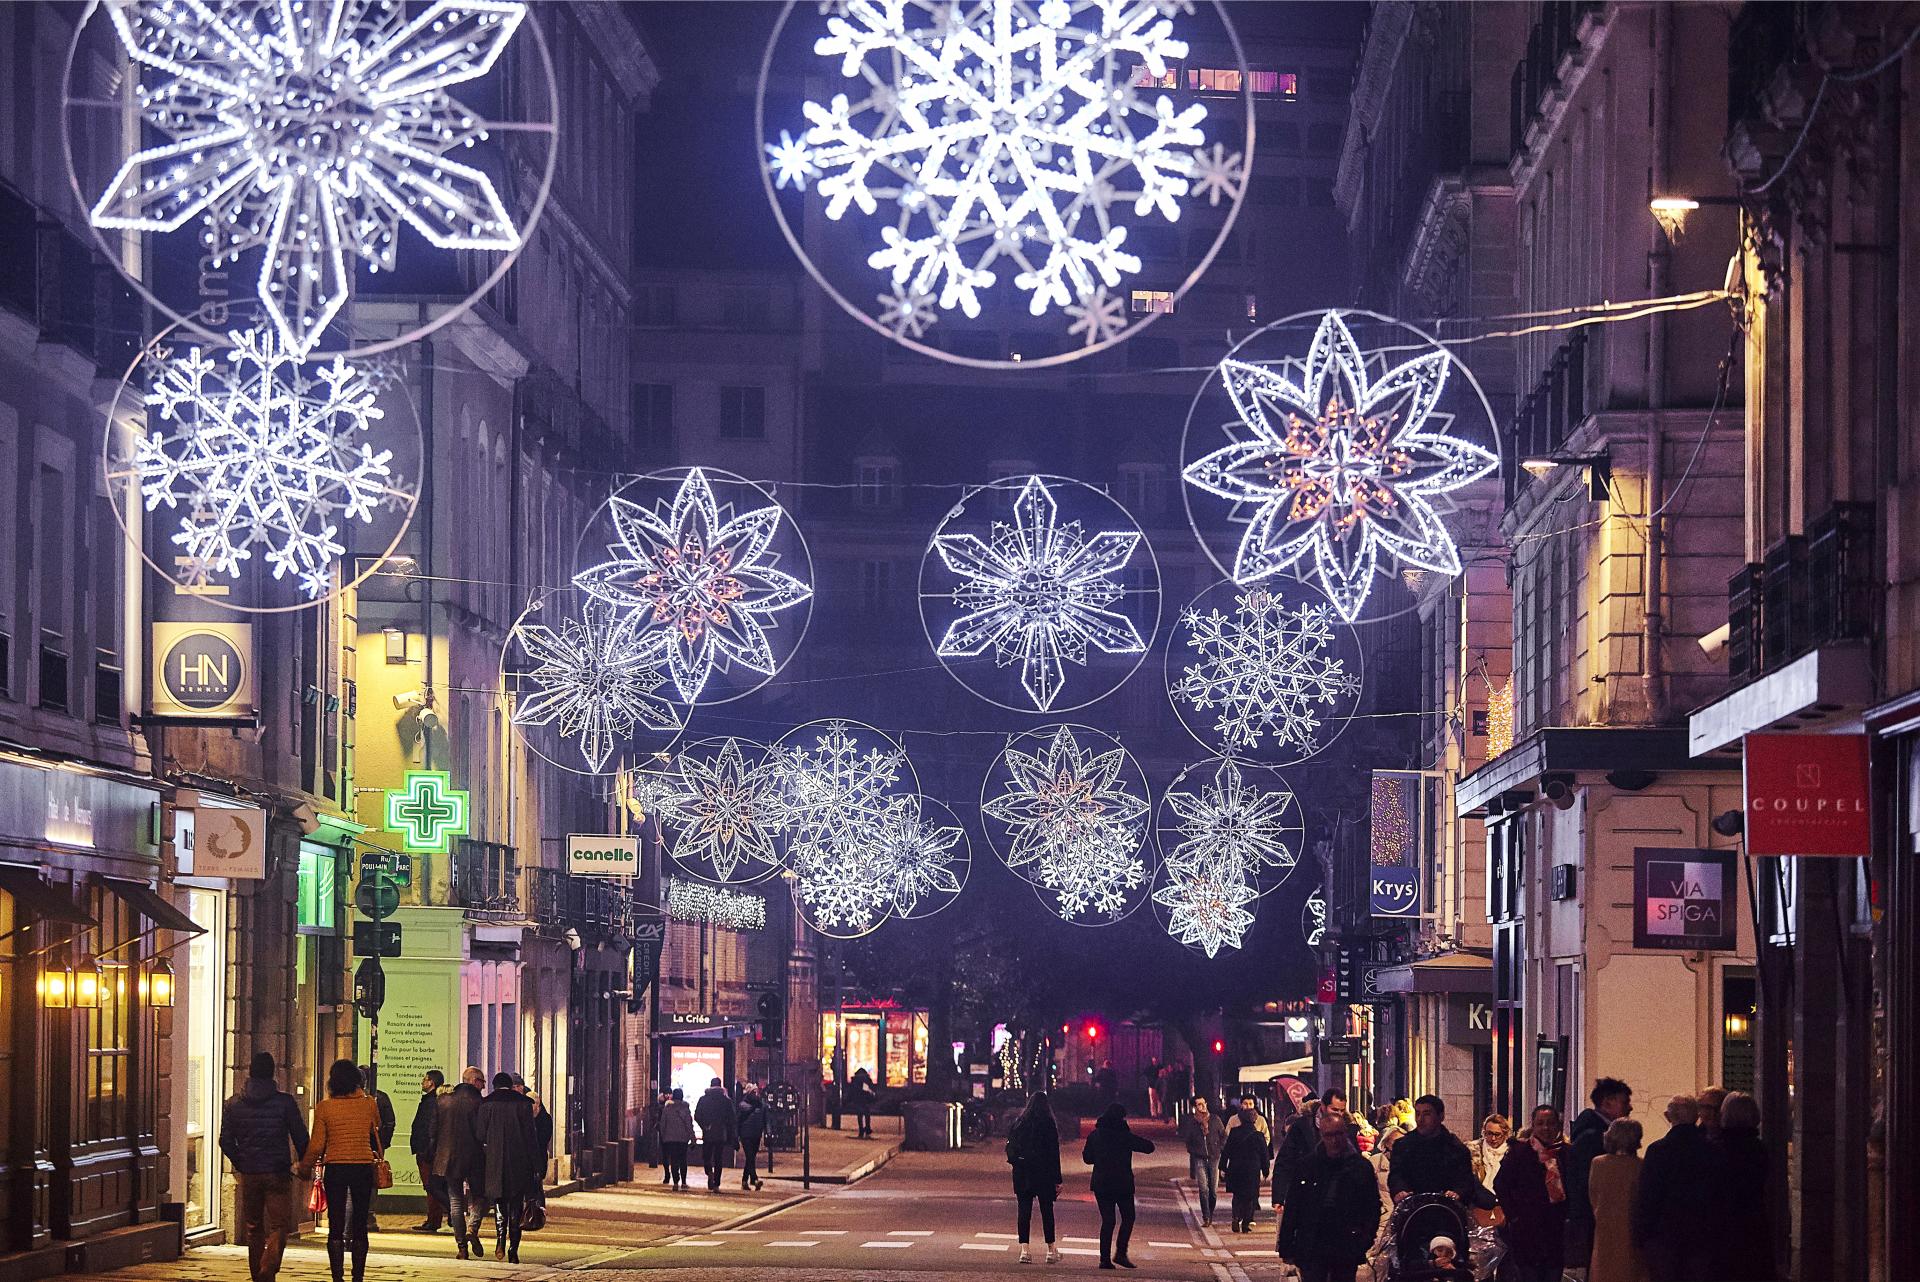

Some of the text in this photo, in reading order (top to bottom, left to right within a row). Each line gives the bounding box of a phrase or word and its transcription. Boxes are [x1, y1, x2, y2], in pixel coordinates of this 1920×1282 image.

[180, 653, 228, 686] HN
[1752, 797, 1865, 812] COUPEL
[573, 848, 634, 862] canelle
[1373, 879, 1413, 901] Krys
[1670, 881, 1705, 897] VIA
[1656, 904, 1717, 922] SPIGA
[673, 1014, 710, 1024] La Criée
